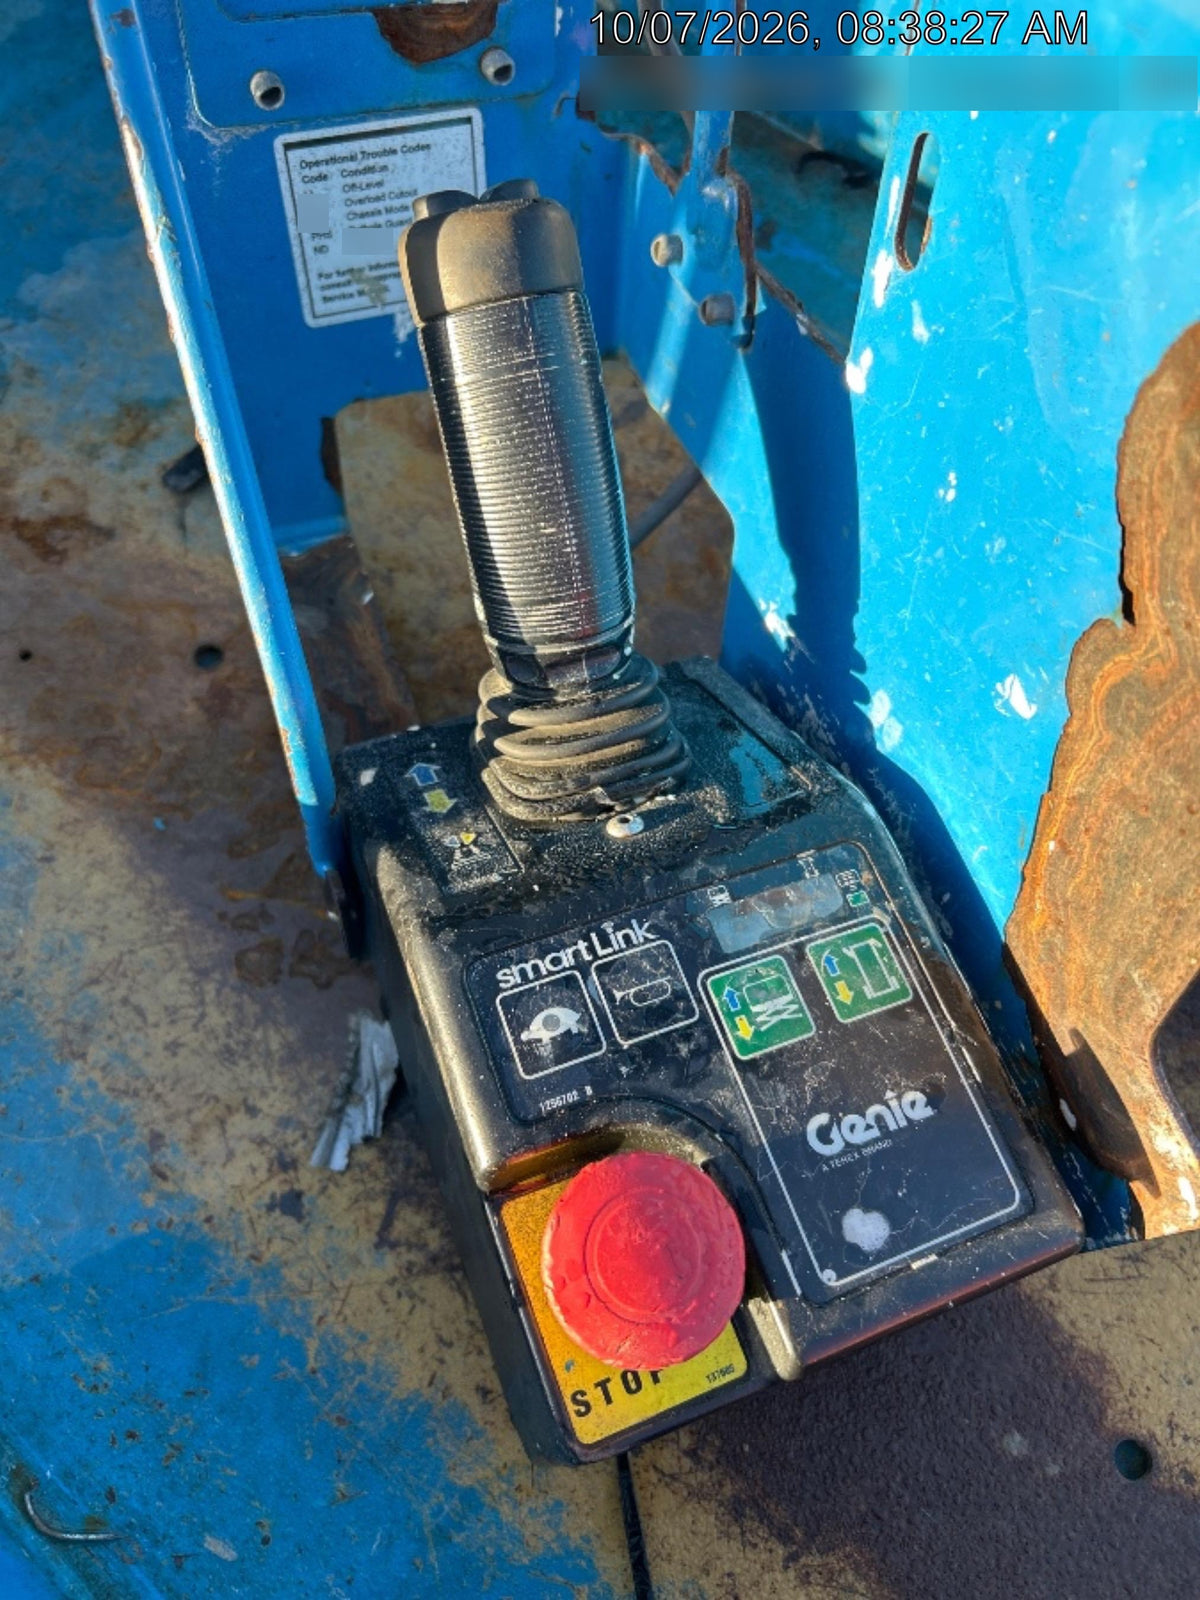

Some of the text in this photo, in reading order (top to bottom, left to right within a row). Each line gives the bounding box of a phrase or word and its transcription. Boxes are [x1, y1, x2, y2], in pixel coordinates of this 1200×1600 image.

[300, 143, 431, 170] Operational Trouble Codes
[302, 173, 328, 184] Code
[807, 1089, 934, 1156] Genie
